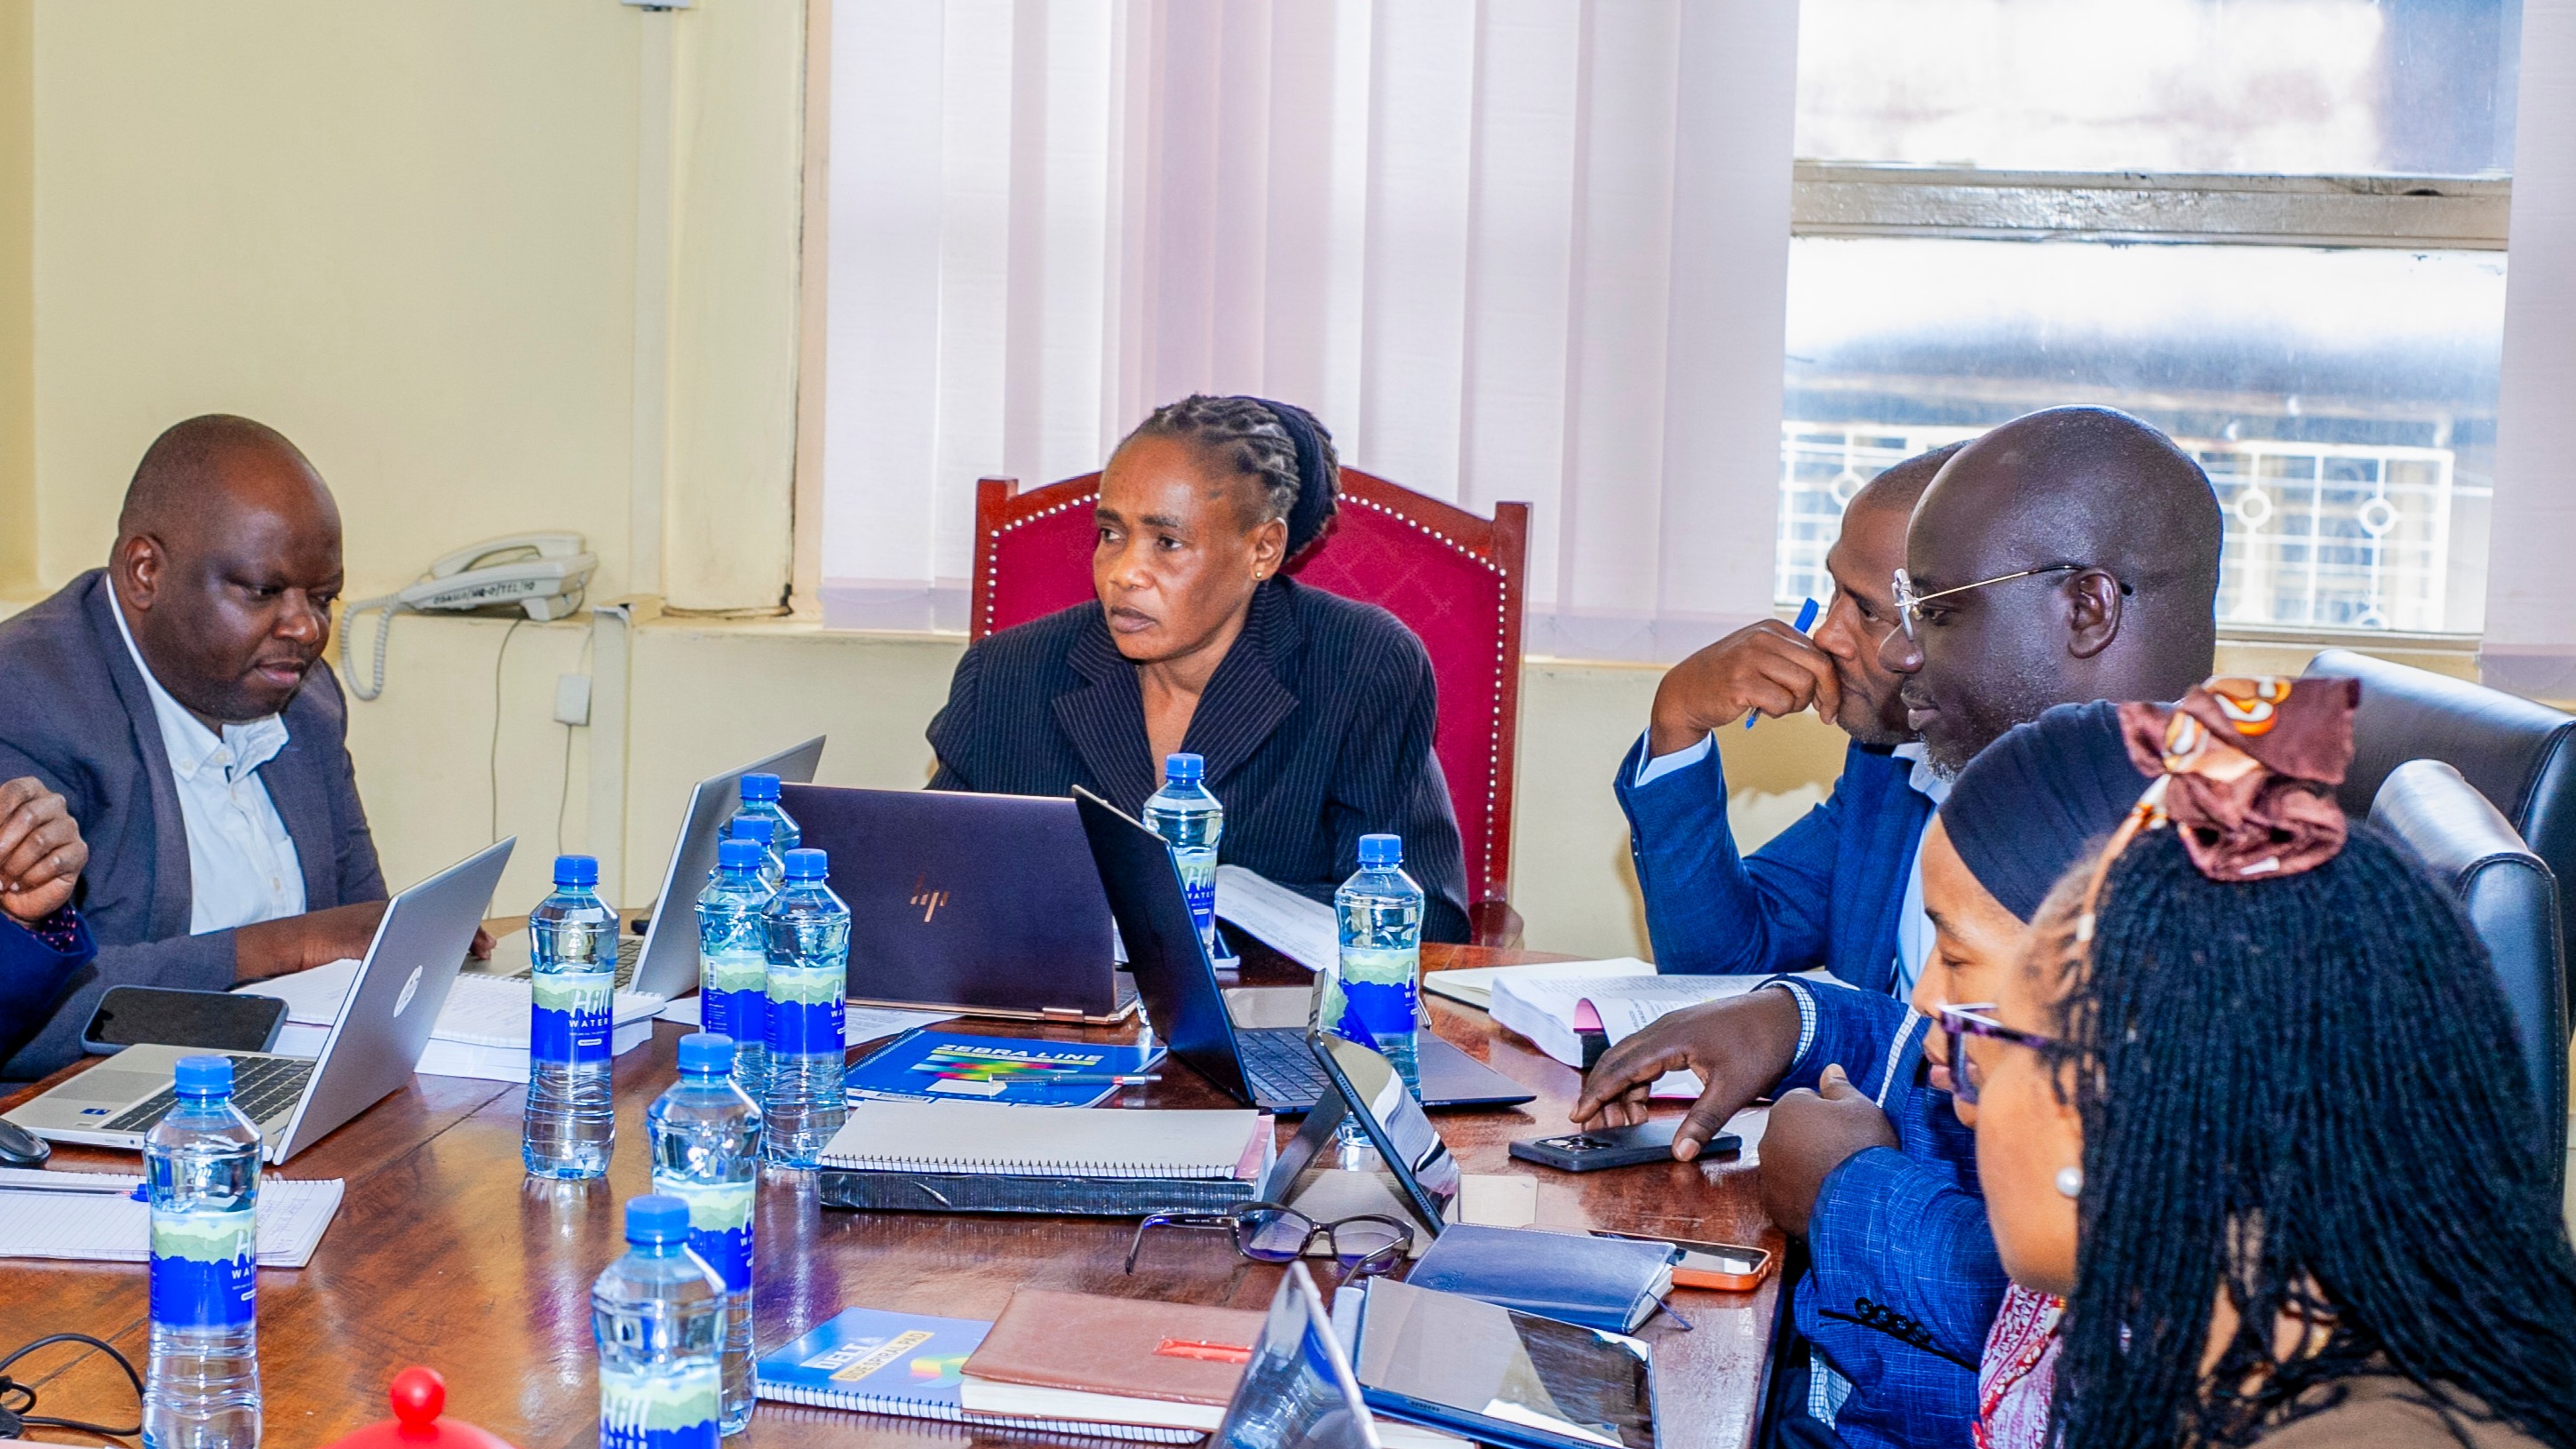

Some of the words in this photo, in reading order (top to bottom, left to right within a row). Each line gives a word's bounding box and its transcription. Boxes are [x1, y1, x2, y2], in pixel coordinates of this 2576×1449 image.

[569, 988, 610, 1019] Hill
[568, 1018, 608, 1028] WATER
[936, 1044, 1029, 1057] ZEBRA
[1037, 1052, 1105, 1063] LINE
[899, 1333, 926, 1347] PAD
